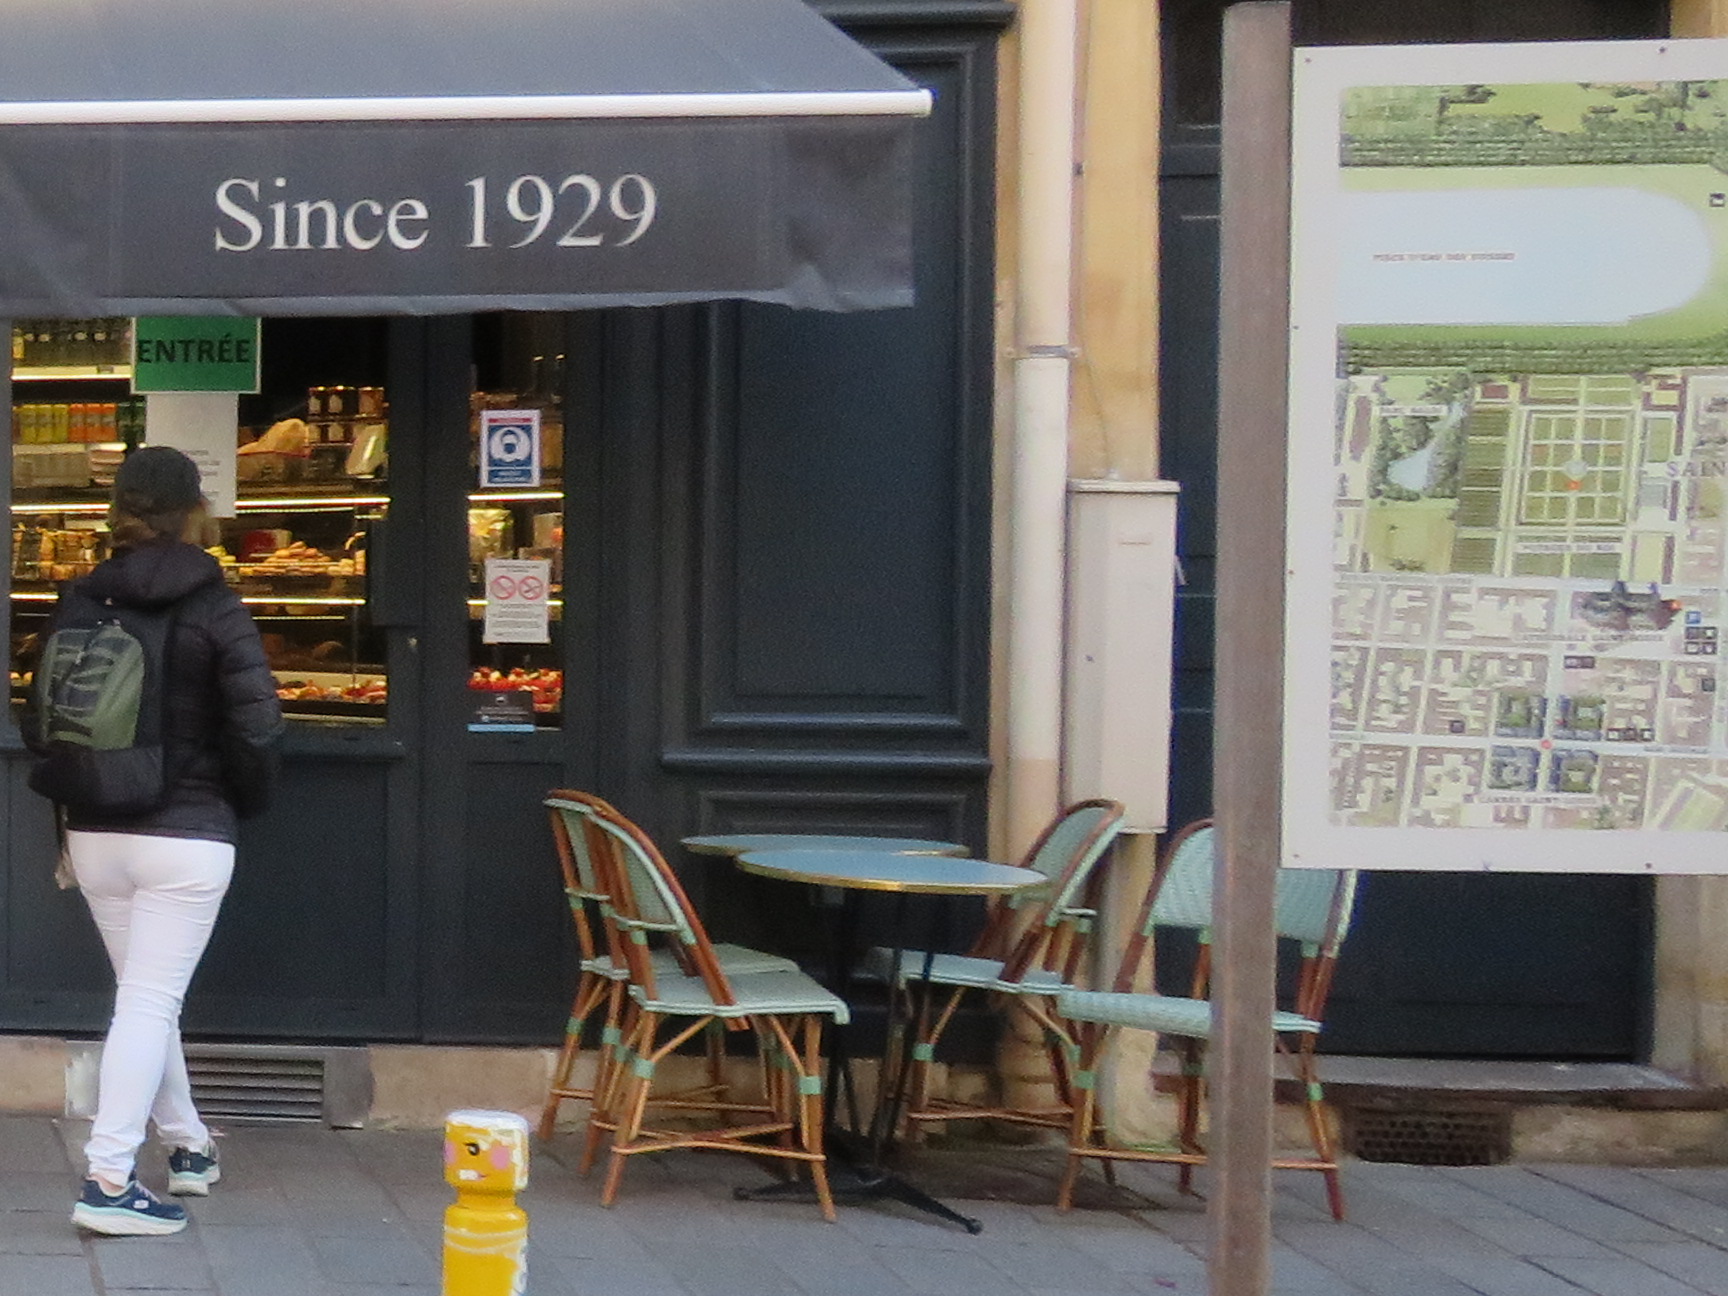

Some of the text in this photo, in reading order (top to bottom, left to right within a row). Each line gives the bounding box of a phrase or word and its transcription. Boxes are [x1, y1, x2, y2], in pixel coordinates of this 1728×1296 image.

[215, 173, 658, 251] Since 1929
[137, 333, 252, 365] ENTRÉE
